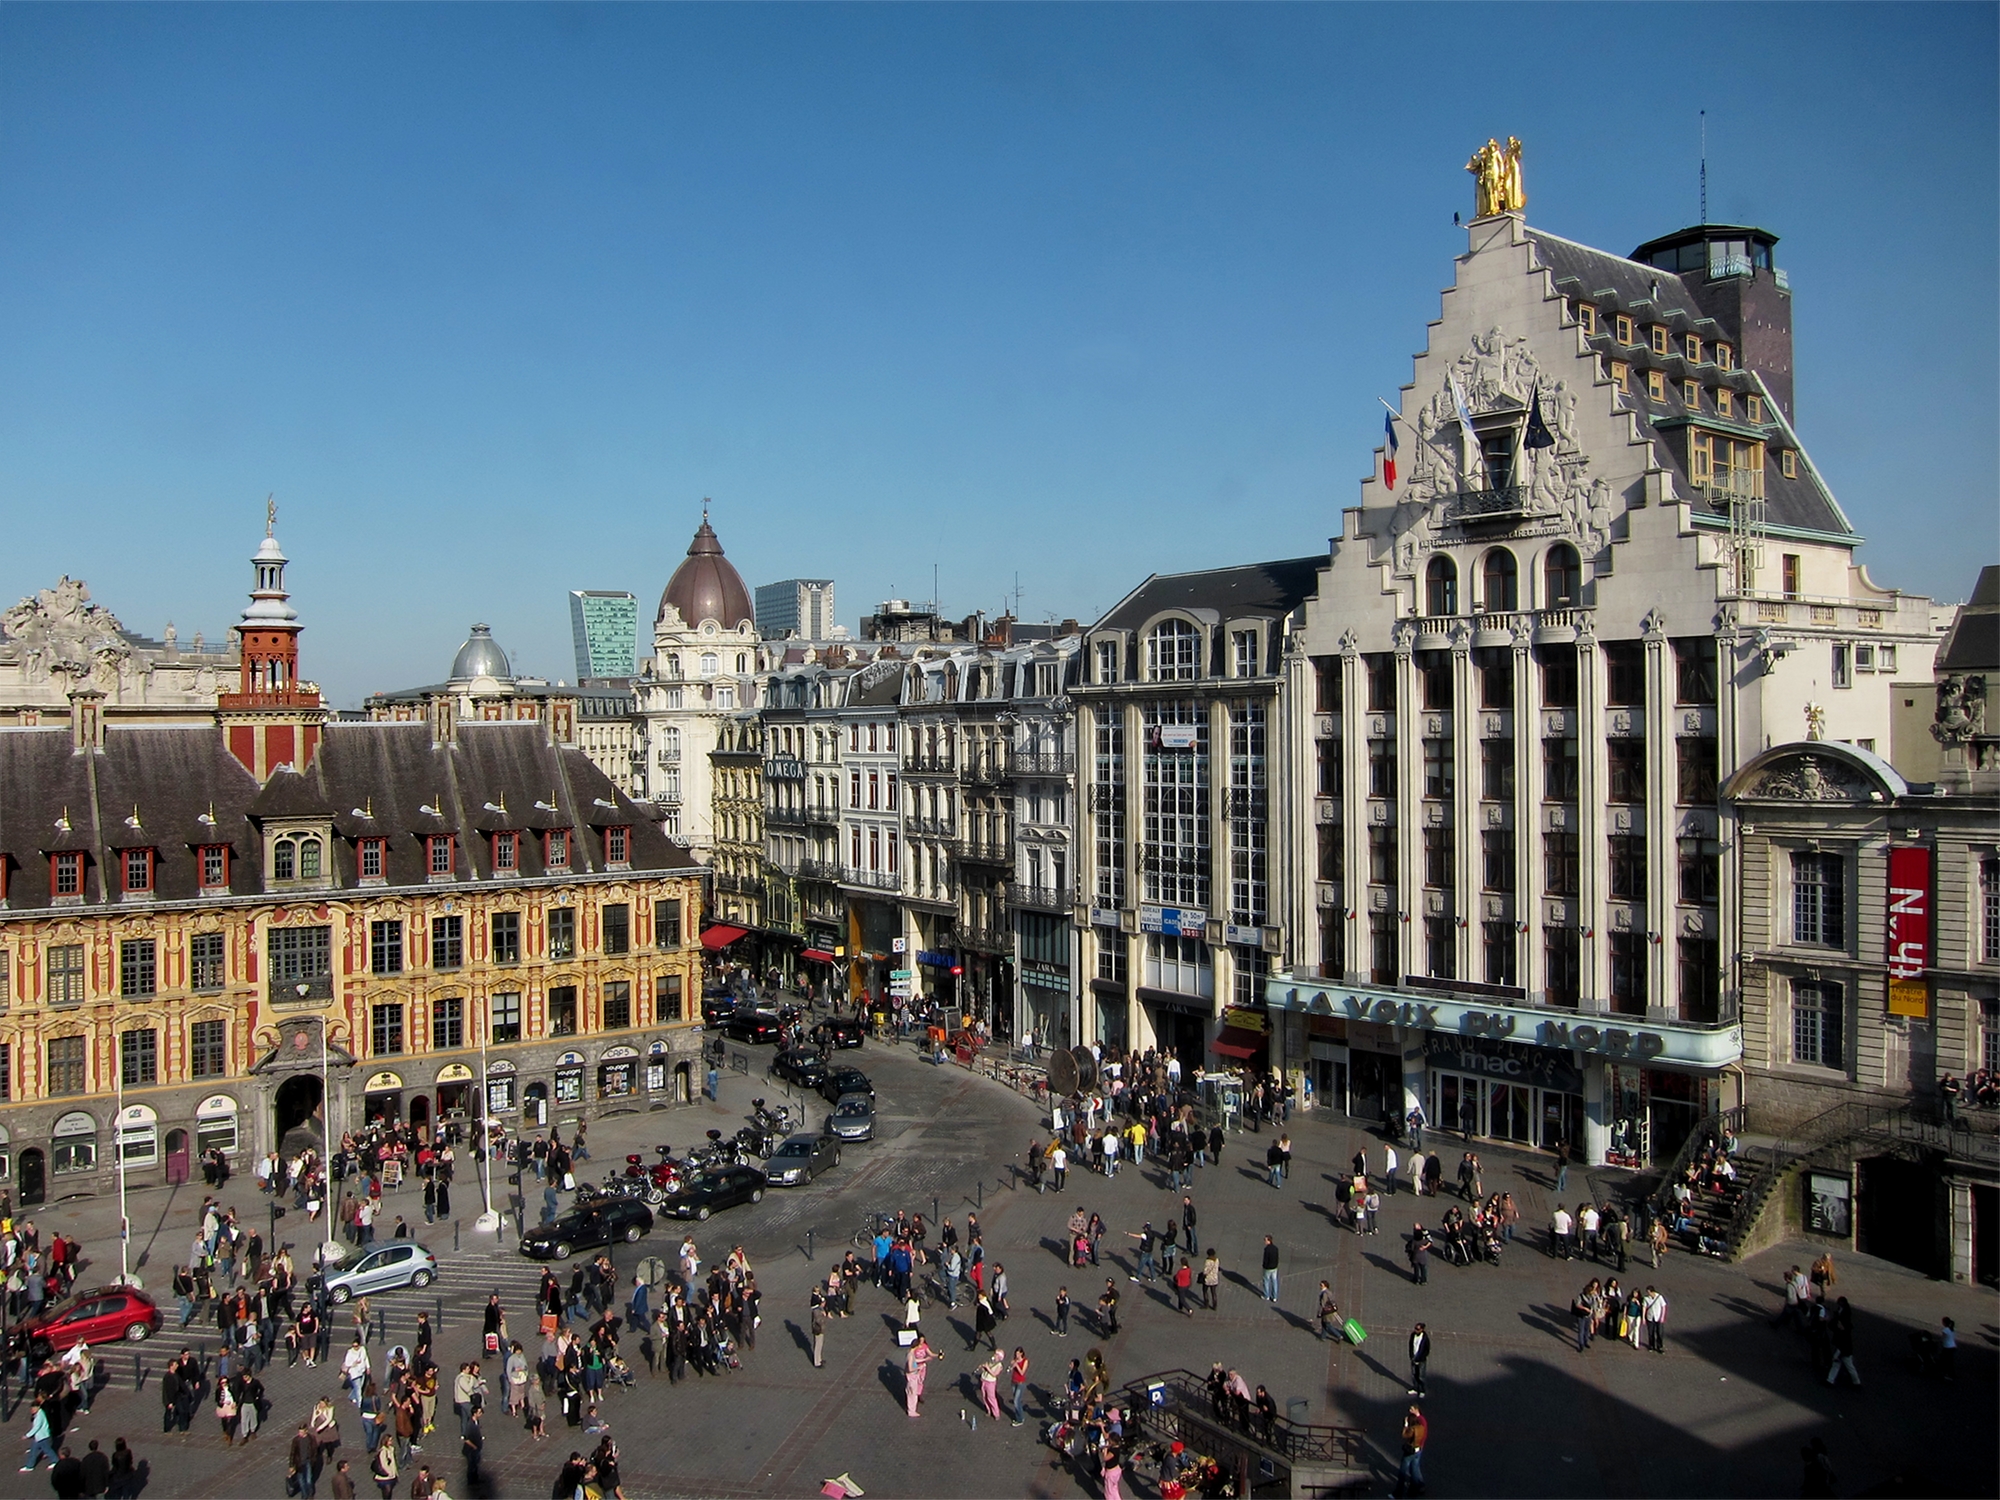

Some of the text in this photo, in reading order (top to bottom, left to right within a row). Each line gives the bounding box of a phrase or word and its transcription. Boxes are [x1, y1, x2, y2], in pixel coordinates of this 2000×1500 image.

[767, 761, 804, 778] OMEGA
[1036, 962, 1056, 973] ZARA
[1165, 1002, 1189, 1014] ZARA
[1286, 988, 1336, 1014] LA
[1344, 996, 1438, 1028] VOIX
[1460, 1011, 1515, 1037] DU
[1537, 1020, 1665, 1057] NORD
[1497, 1041, 1557, 1075] PLACE
